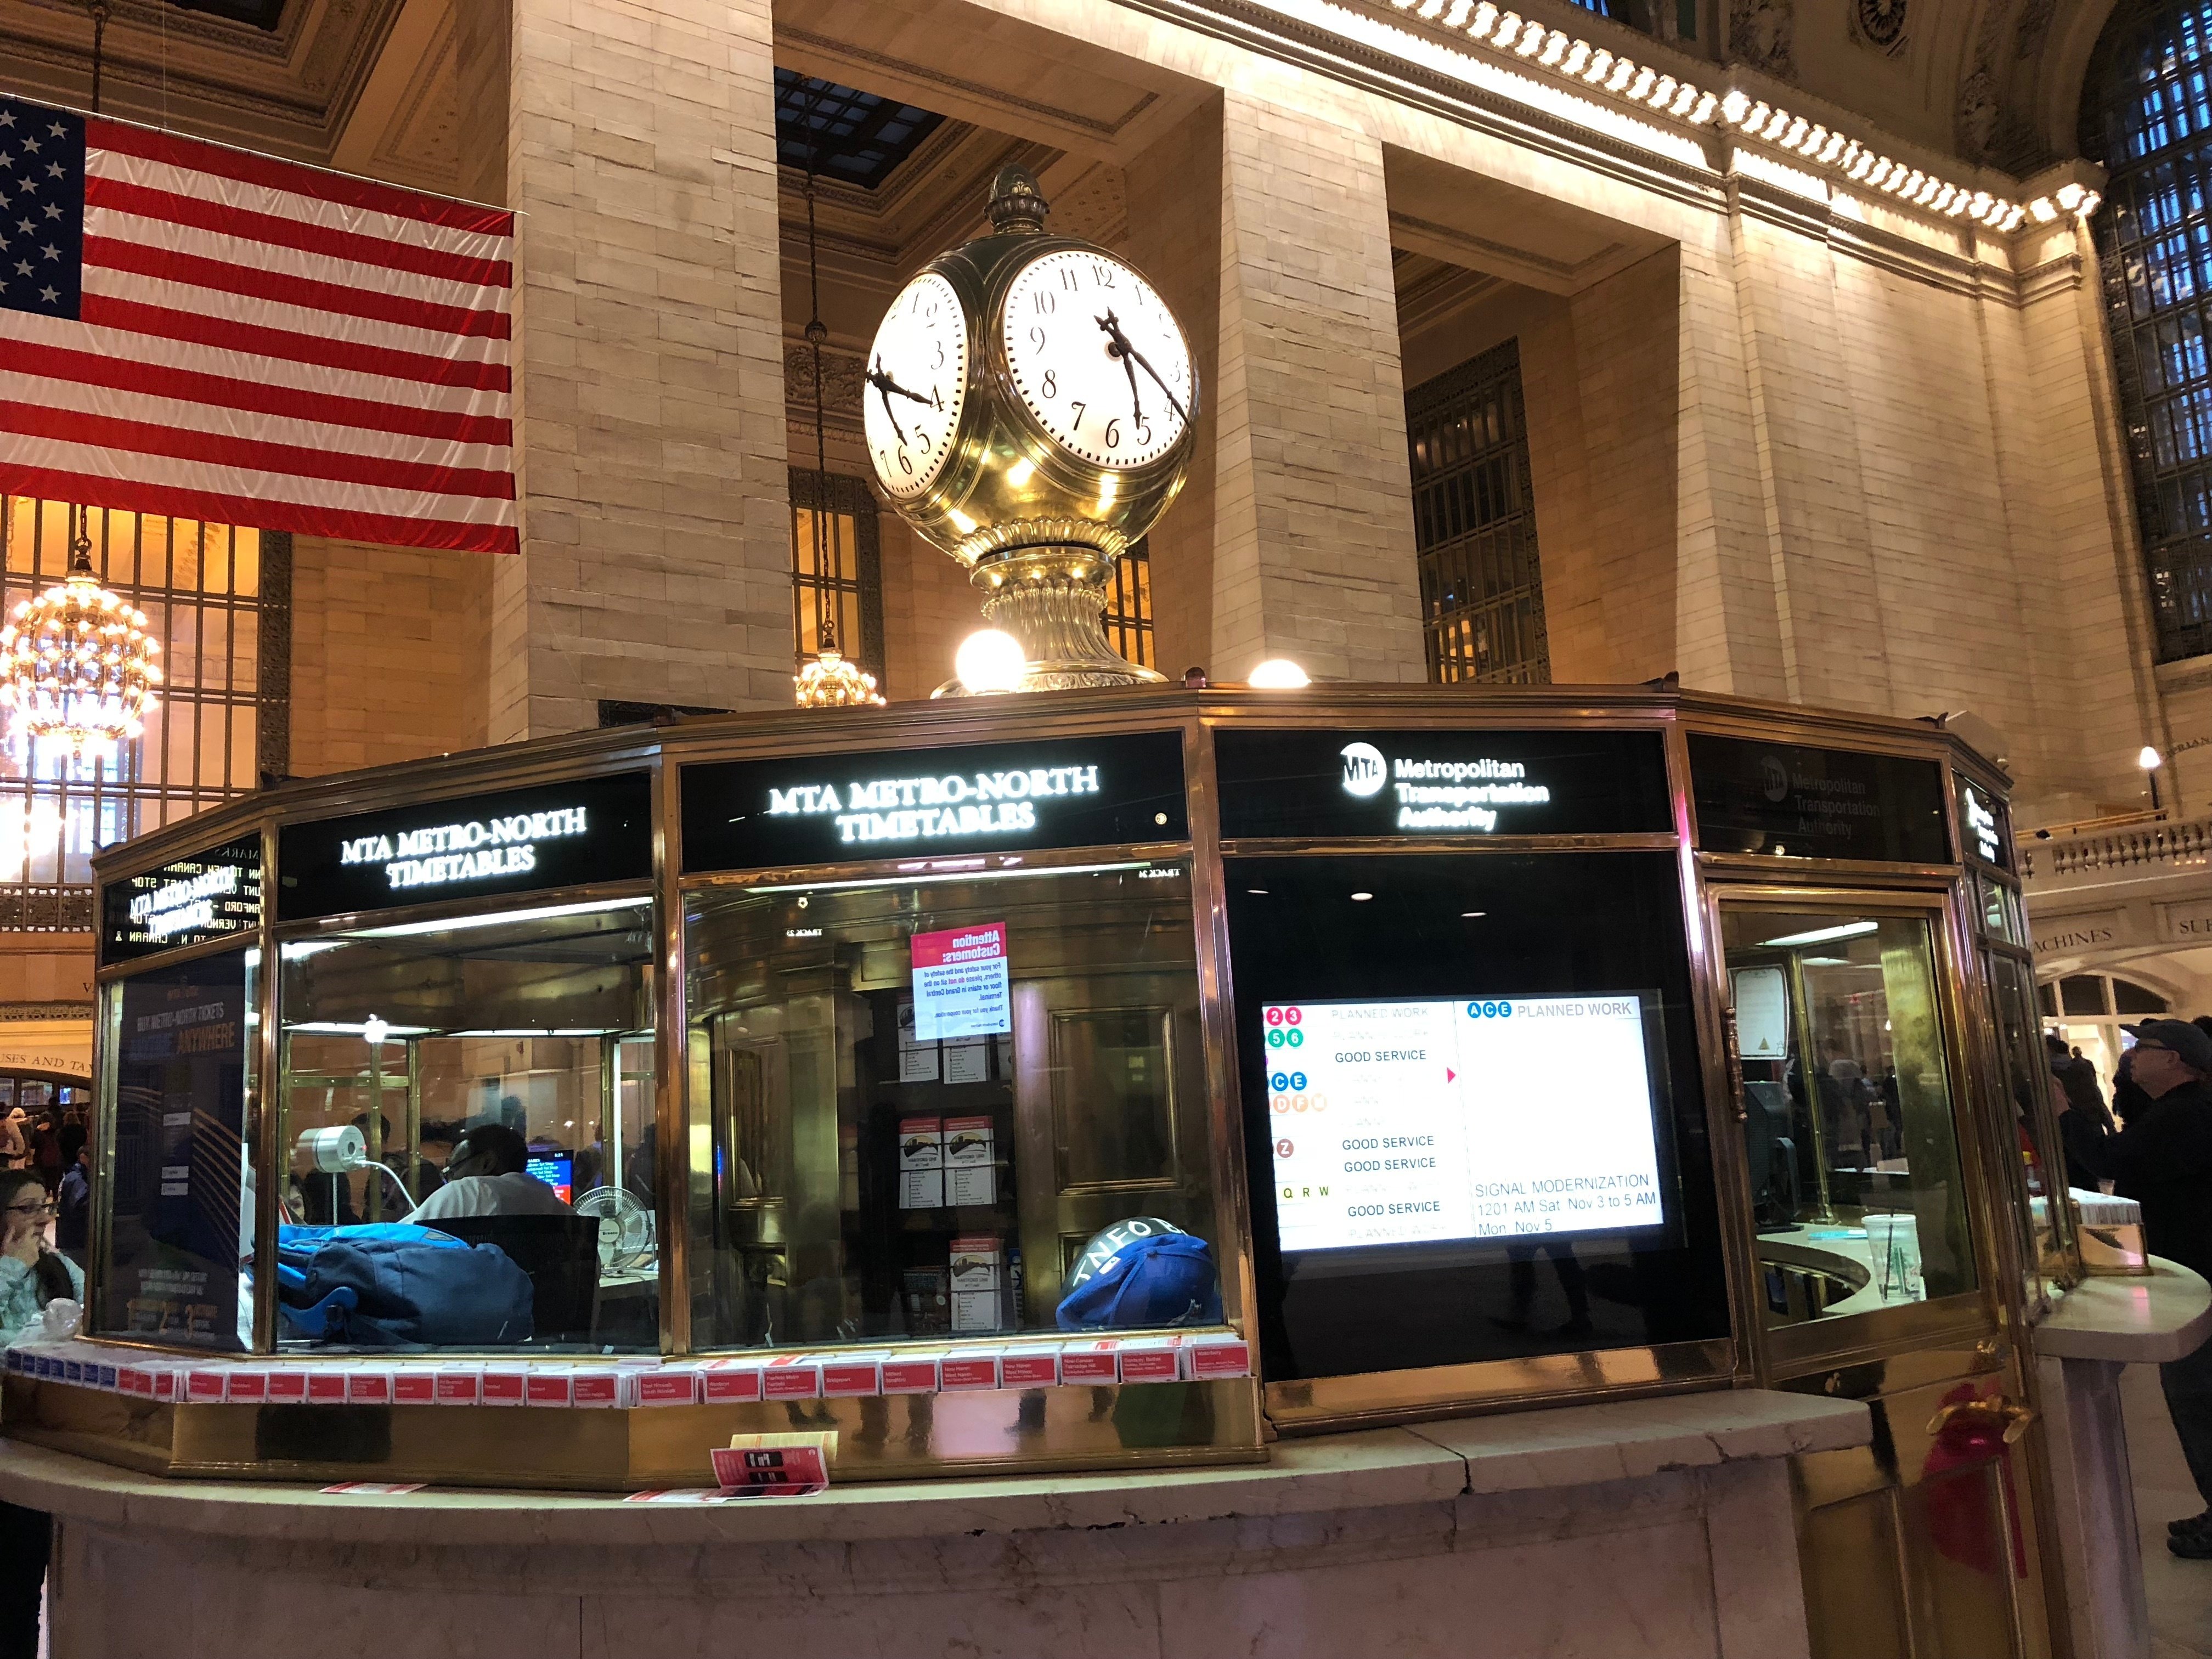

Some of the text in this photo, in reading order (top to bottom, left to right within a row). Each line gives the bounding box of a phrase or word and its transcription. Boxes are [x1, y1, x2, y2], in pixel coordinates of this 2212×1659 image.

[1059, 268, 1077, 291] 11
[1092, 264, 1115, 289] 12
[912, 292, 919, 313] 1
[1033, 290, 1055, 314] 10
[1135, 285, 1143, 306] 1
[1030, 326, 1046, 355] 9
[931, 341, 944, 370] 3
[1042, 369, 1057, 398] 8
[930, 383, 945, 413] 4
[1163, 396, 1176, 421] 4
[1071, 401, 1086, 431] 7
[915, 424, 931, 455] 5
[1105, 418, 1120, 449] 6
[1137, 416, 1151, 445] 5
[880, 450, 892, 478] 7
[898, 445, 912, 475] 6
[1394, 758, 1526, 782] Metropolitan
[769, 766, 1100, 815] MTA METRO-NORTH
[1394, 782, 1550, 807] Transportation
[1792, 772, 1866, 795] Metropolitan
[1795, 794, 1881, 817] Transportation
[835, 801, 1036, 843] TIMETABLES
[1398, 806, 1497, 831] Authority
[1798, 816, 1852, 840] Authority
[340, 806, 587, 865] MTA METRO-NORTH
[386, 845, 537, 888] TIMETABLES
[1392, 1008, 1427, 1017] WORK
[1518, 1005, 1584, 1017] PLANNED
[1588, 1002, 1632, 1015] WORK
[31, 1056, 64, 1068] AND
[1335, 1050, 1426, 1063] GOOD SERVICE
[1342, 1139, 1378, 1150] GOOD
[1383, 1136, 1434, 1148] SERVICE
[1344, 1158, 1436, 1172] GOOD SERVICE
[1283, 1186, 1329, 1198] Q R W
[1475, 1174, 1649, 1197] SIGNAL MODERNIZATION
[1348, 1201, 1440, 1217] GOOD SERVICE
[1514, 1201, 1534, 1213] AM
[1539, 1199, 1560, 1212] Sat
[1568, 1198, 1593, 1210] Nov
[1597, 1195, 1604, 1207] 3
[1609, 1195, 1620, 1207] to
[1624, 1194, 1632, 1206] 5
[1637, 1192, 1656, 1205] AM
[1479, 1218, 1552, 1235] Mon Nov 5
[1073, 1221, 1152, 1287] INFO
